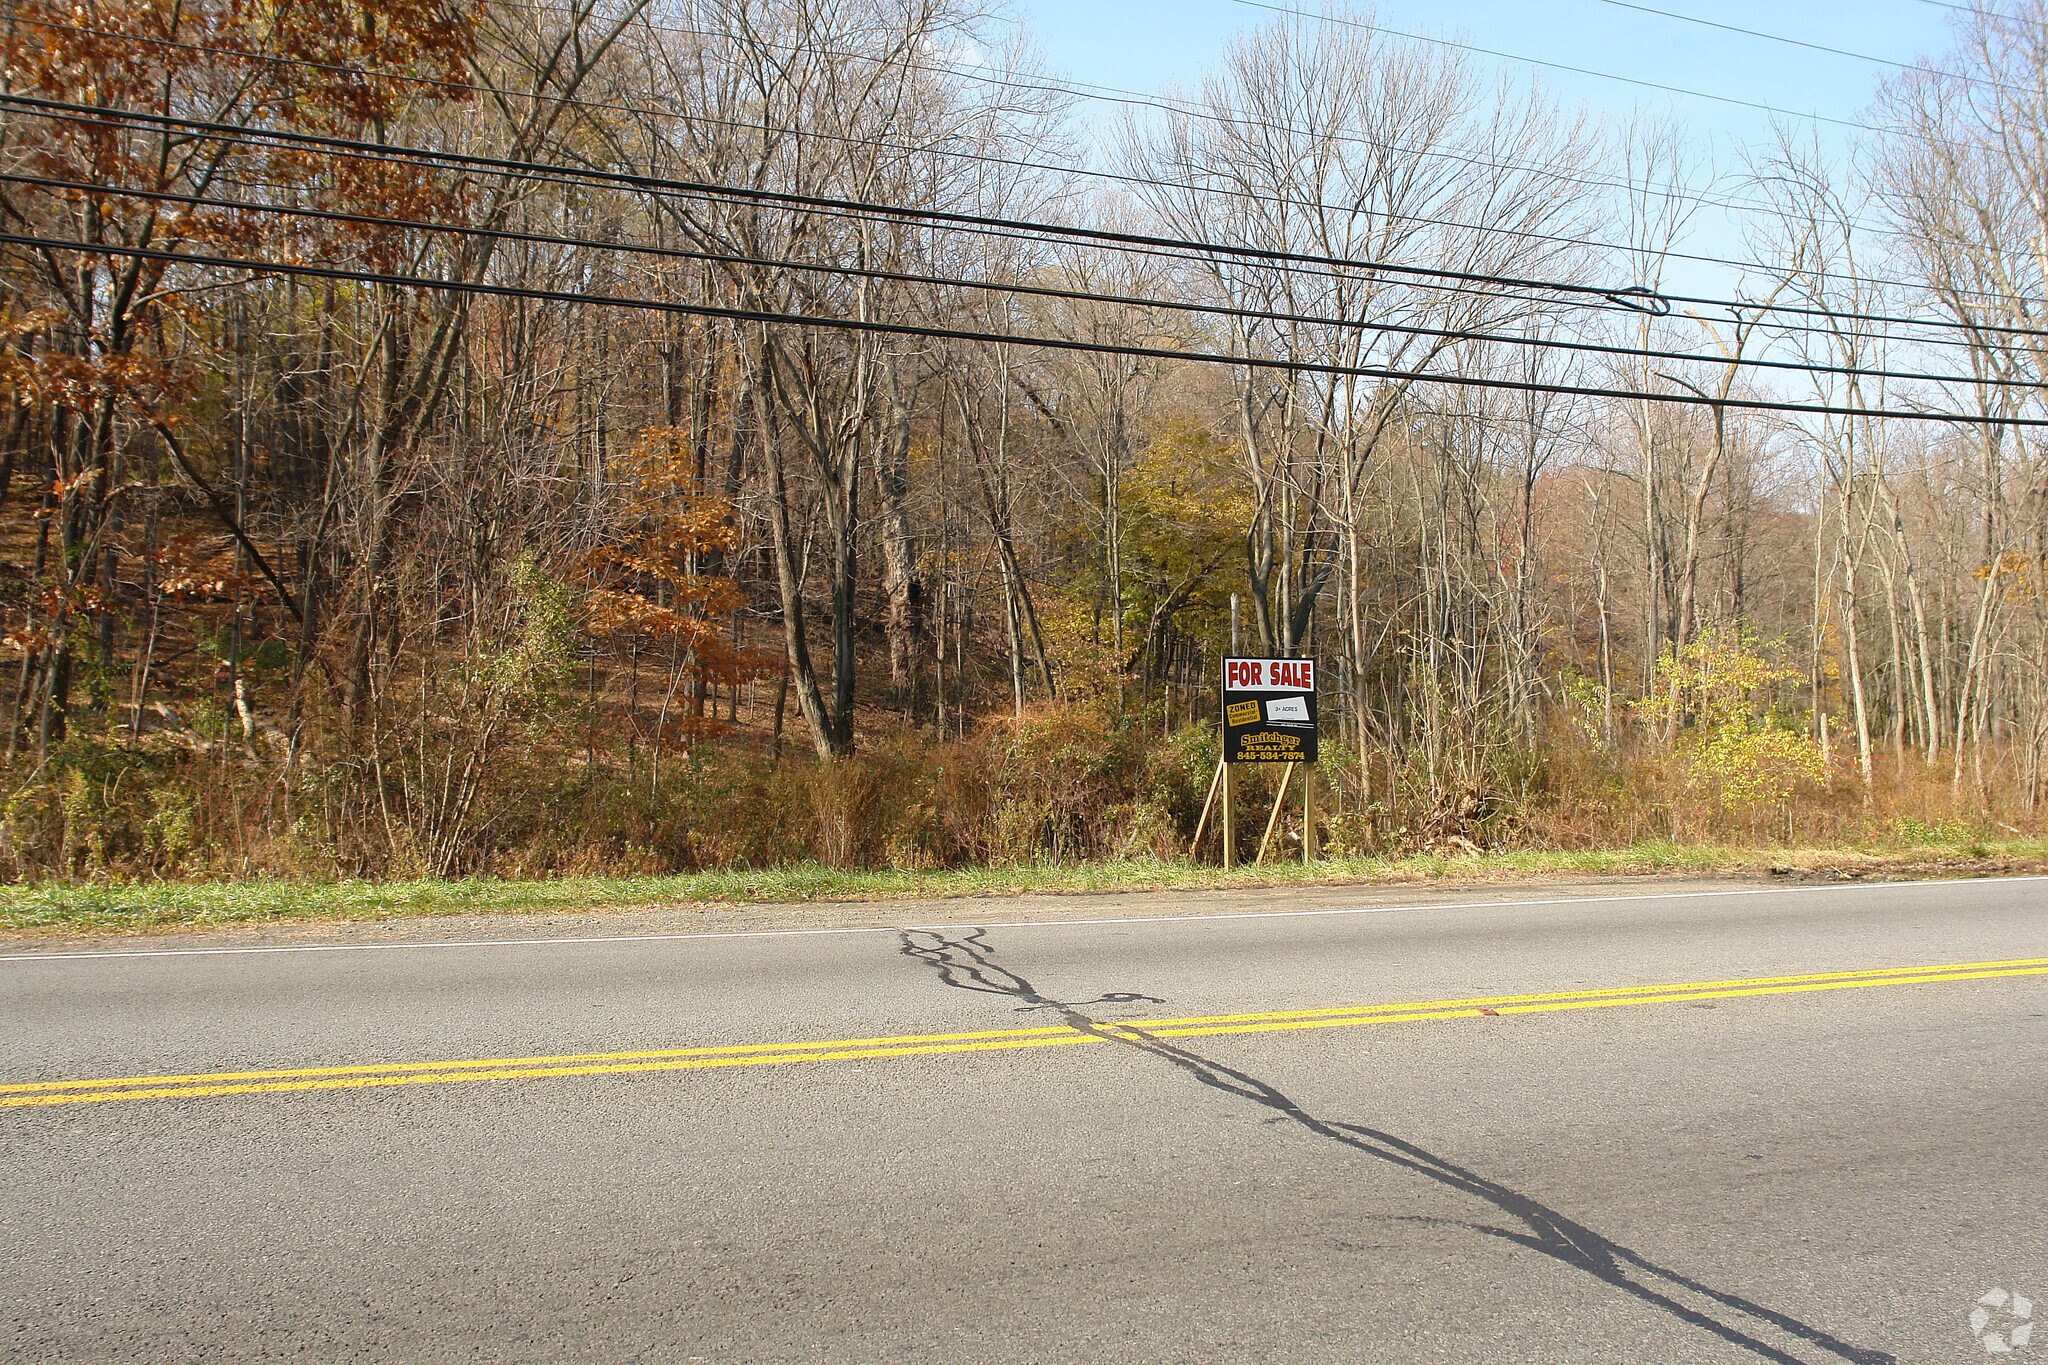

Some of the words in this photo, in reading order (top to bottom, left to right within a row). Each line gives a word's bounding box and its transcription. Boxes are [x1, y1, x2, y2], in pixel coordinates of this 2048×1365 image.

[1228, 661, 1262, 688] FOR
[1270, 662, 1311, 689] SALE
[1229, 702, 1256, 713] ZONED
[1241, 732, 1300, 746] Smitchger
[1237, 752, 1305, 760] 845-534-7874
